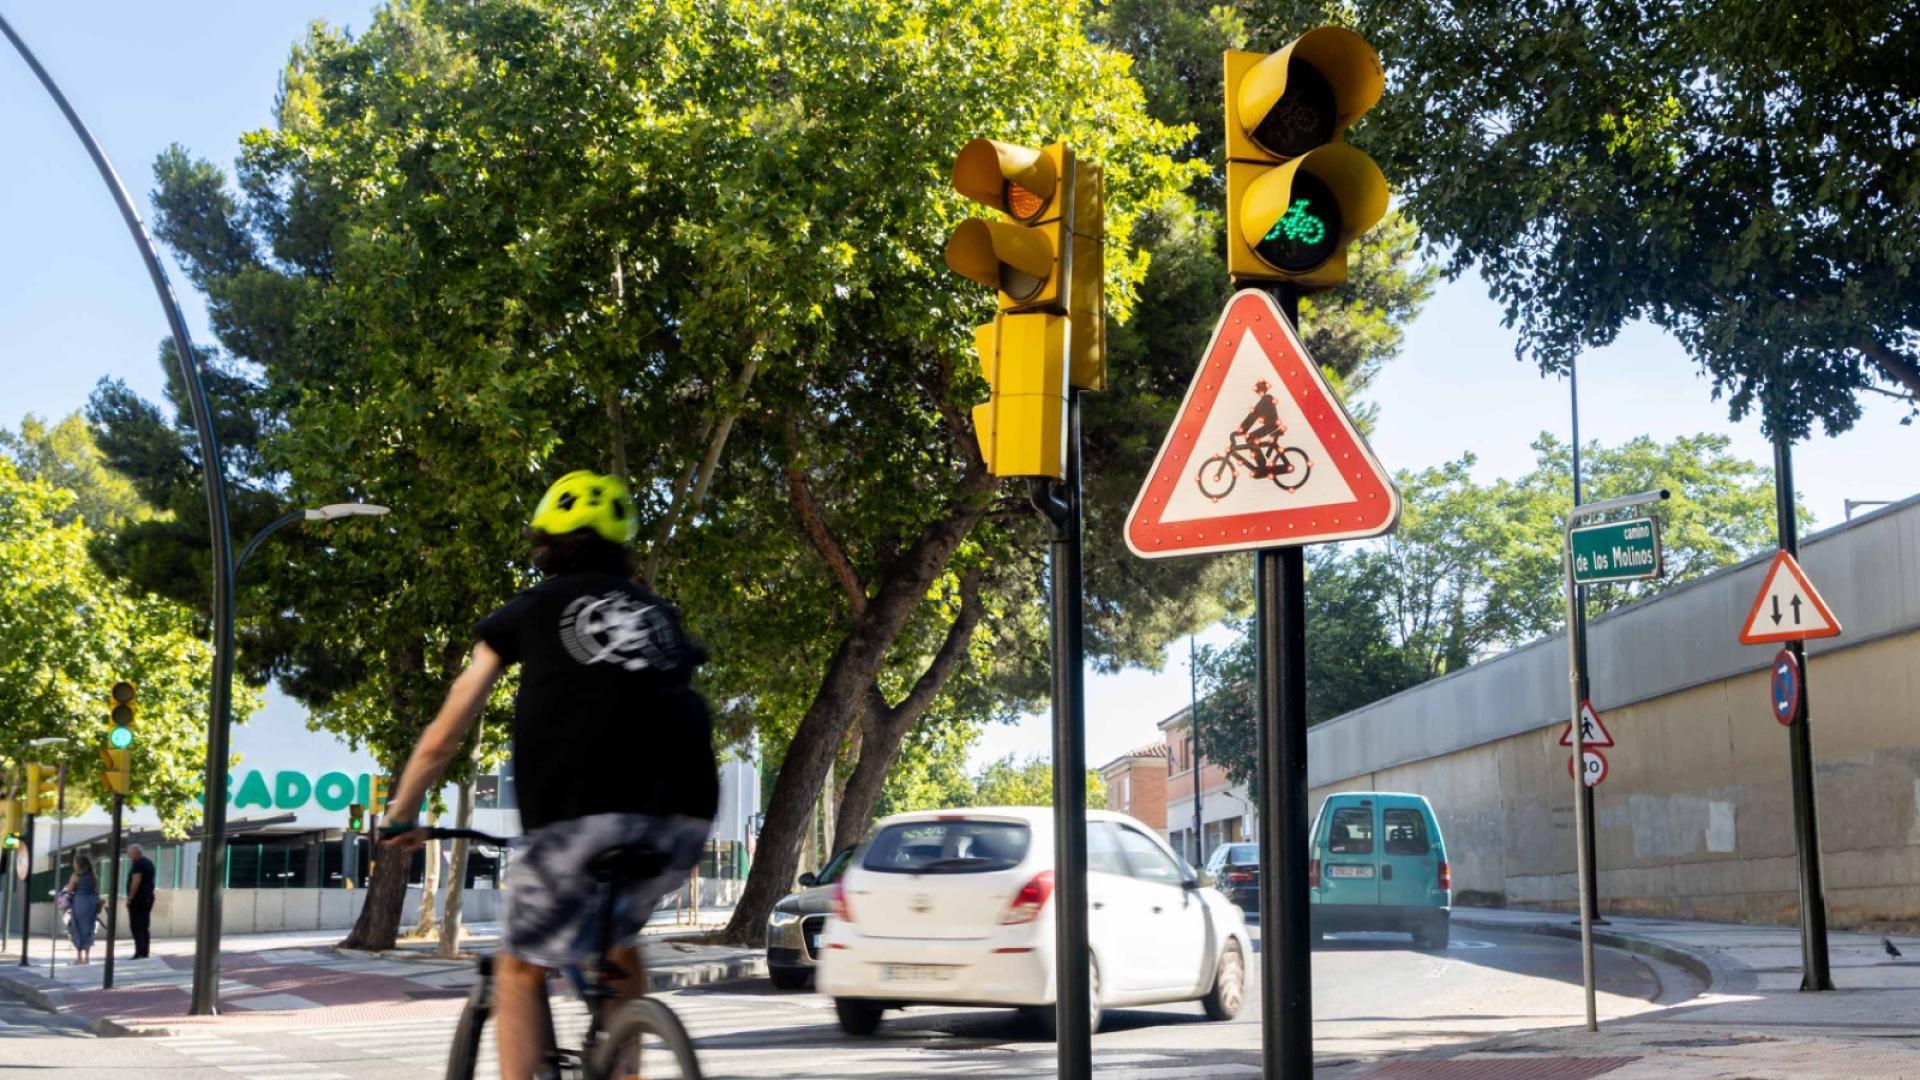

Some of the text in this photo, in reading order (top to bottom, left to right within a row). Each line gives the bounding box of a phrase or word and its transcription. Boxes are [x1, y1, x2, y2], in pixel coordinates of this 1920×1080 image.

[1624, 523, 1650, 540] camino
[1576, 545, 1653, 572] de los Molinos
